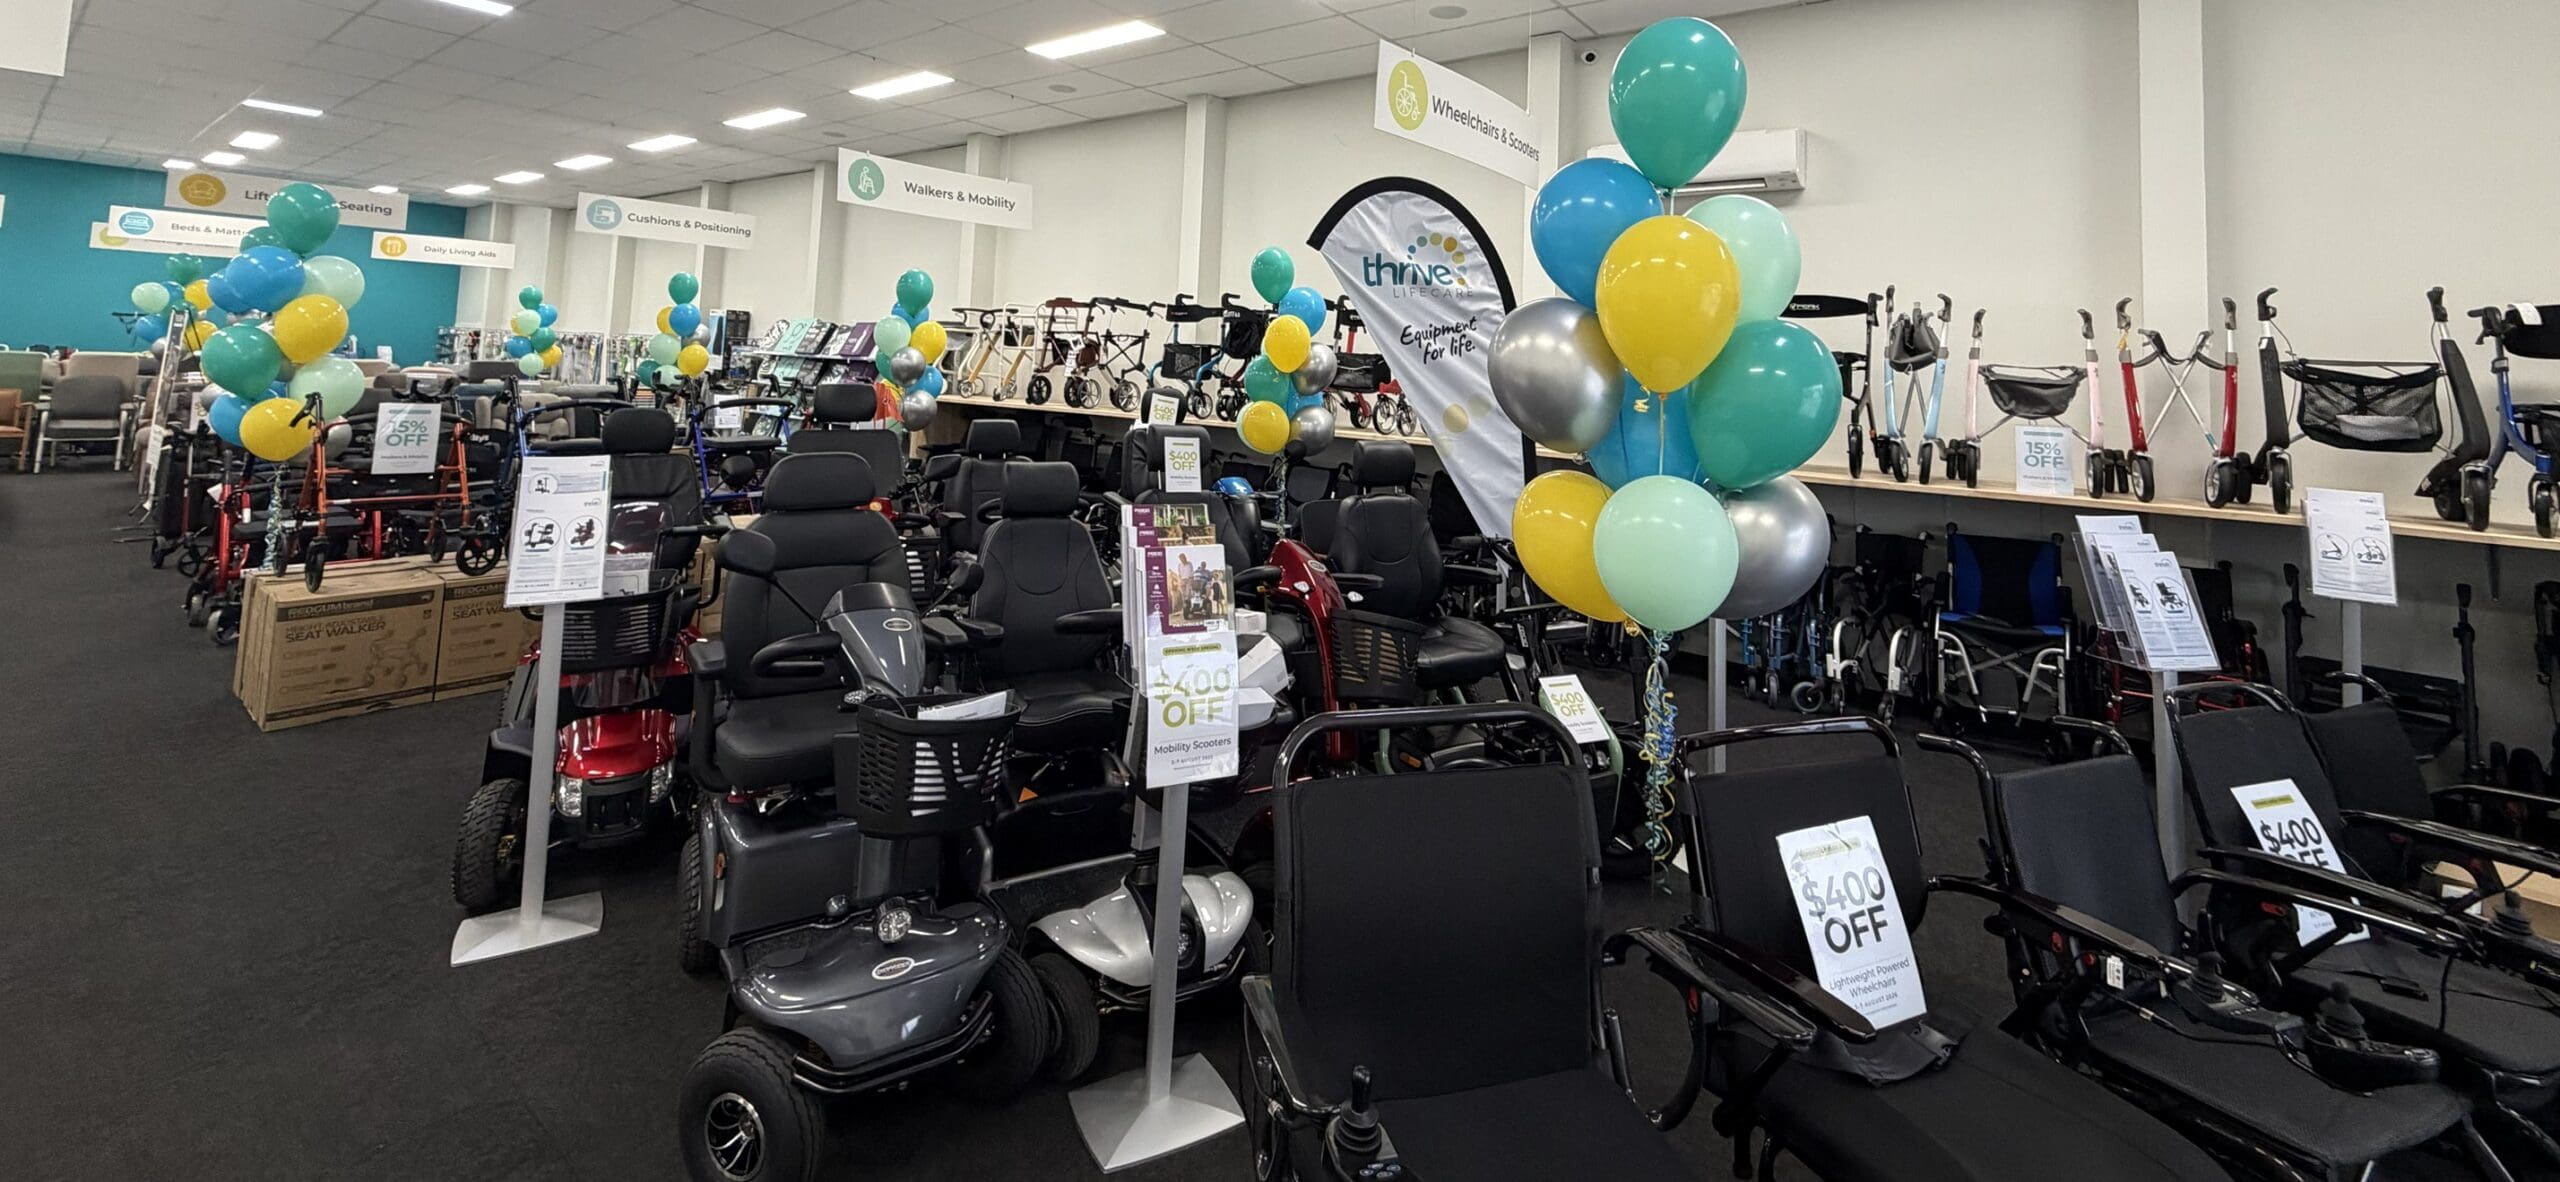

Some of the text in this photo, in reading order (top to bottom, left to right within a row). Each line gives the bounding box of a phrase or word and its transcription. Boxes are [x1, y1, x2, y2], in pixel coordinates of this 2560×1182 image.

[1432, 95, 1540, 161] Wheelchairs & Scooters
[904, 180, 1016, 211] Walkers & Mobility
[340, 201, 393, 216] Seating
[171, 222, 201, 233] Beds
[627, 212, 752, 237] Cushions & Positioning
[424, 245, 497, 258] Daily Living Aids
[1363, 252, 1454, 287] thrive
[1393, 287, 1474, 299] LIFECARE
[1400, 316, 1477, 348] Equipment
[1423, 334, 1476, 365] for life.
[1154, 412, 1173, 422] OFF
[386, 433, 429, 447] OFF
[2025, 441, 2062, 456] 15%
[1168, 449, 1198, 461] $400
[2024, 454, 2064, 468] OFF
[1172, 460, 1195, 471] OFF
[286, 620, 386, 643] SEAT WALKER
[1551, 691, 1584, 706] $400
[1163, 695, 1225, 728] OFF
[1560, 703, 1585, 717] OFF
[1154, 737, 1232, 755] Mobility Scooters
[2260, 816, 2322, 854] $400
[1802, 865, 1886, 922] $400
[1824, 904, 1888, 954] OFF
[1829, 956, 1910, 991] Lightweight Powered
[1849, 976, 1897, 998] Wheelchairs
